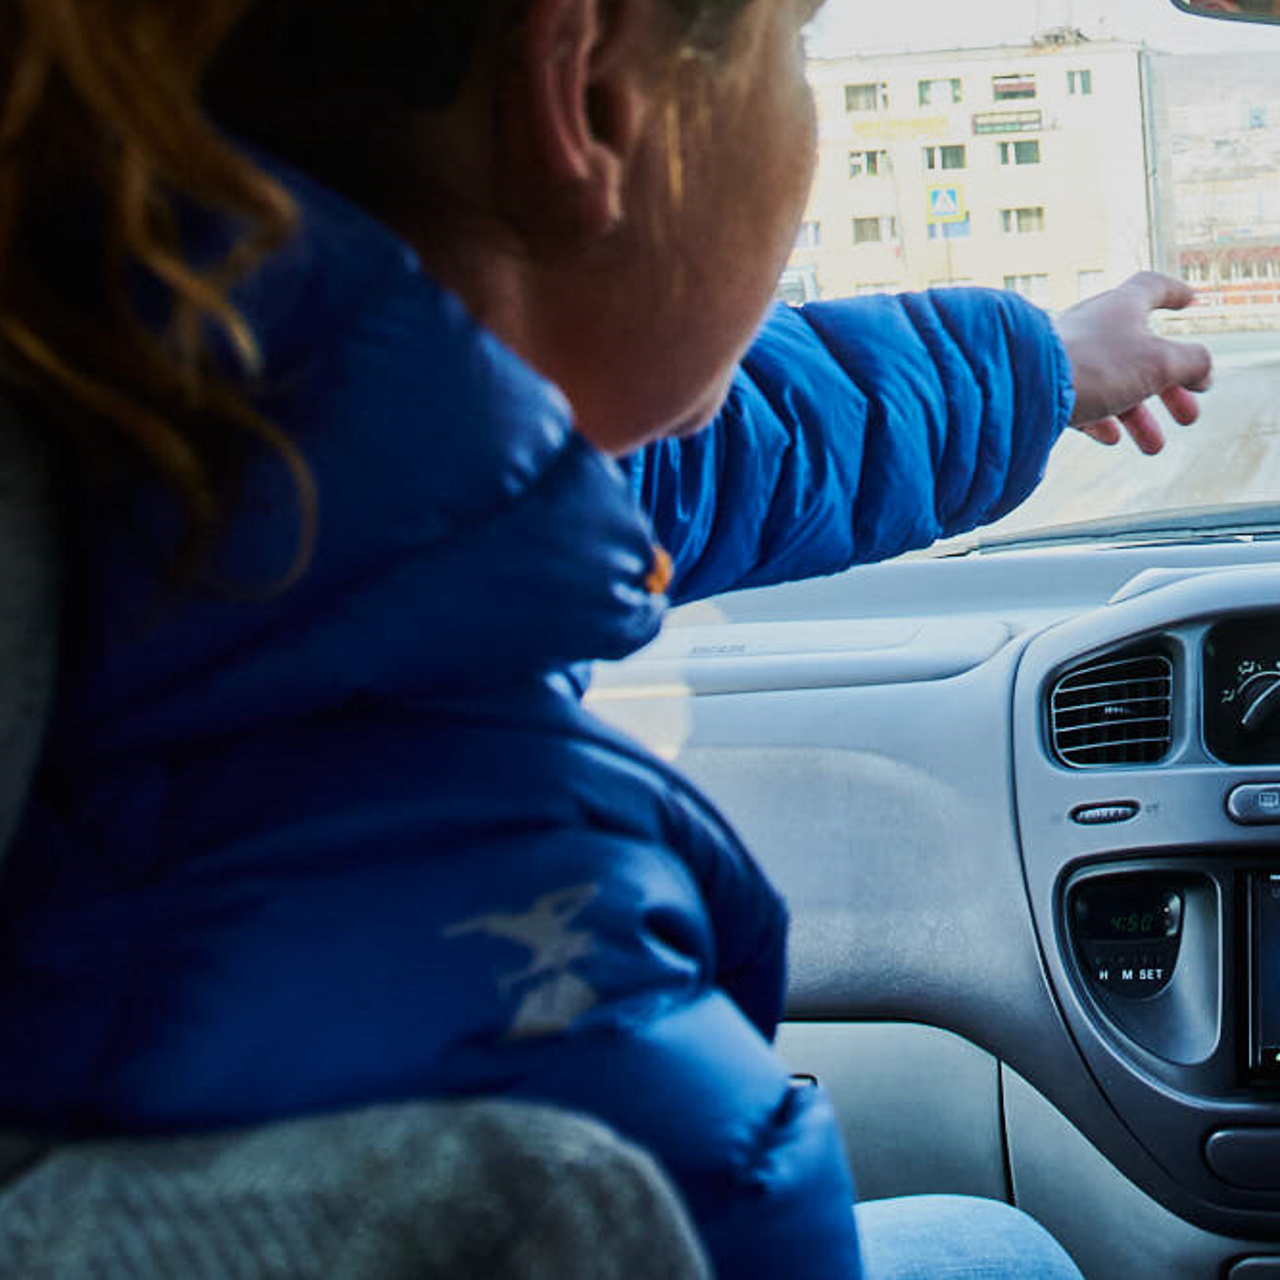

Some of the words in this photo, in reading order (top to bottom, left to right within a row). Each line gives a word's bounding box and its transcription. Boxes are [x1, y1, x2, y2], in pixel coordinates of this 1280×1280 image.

[1099, 969, 1108, 980] H
[1121, 969, 1133, 980] M
[1139, 969, 1163, 980] SET
